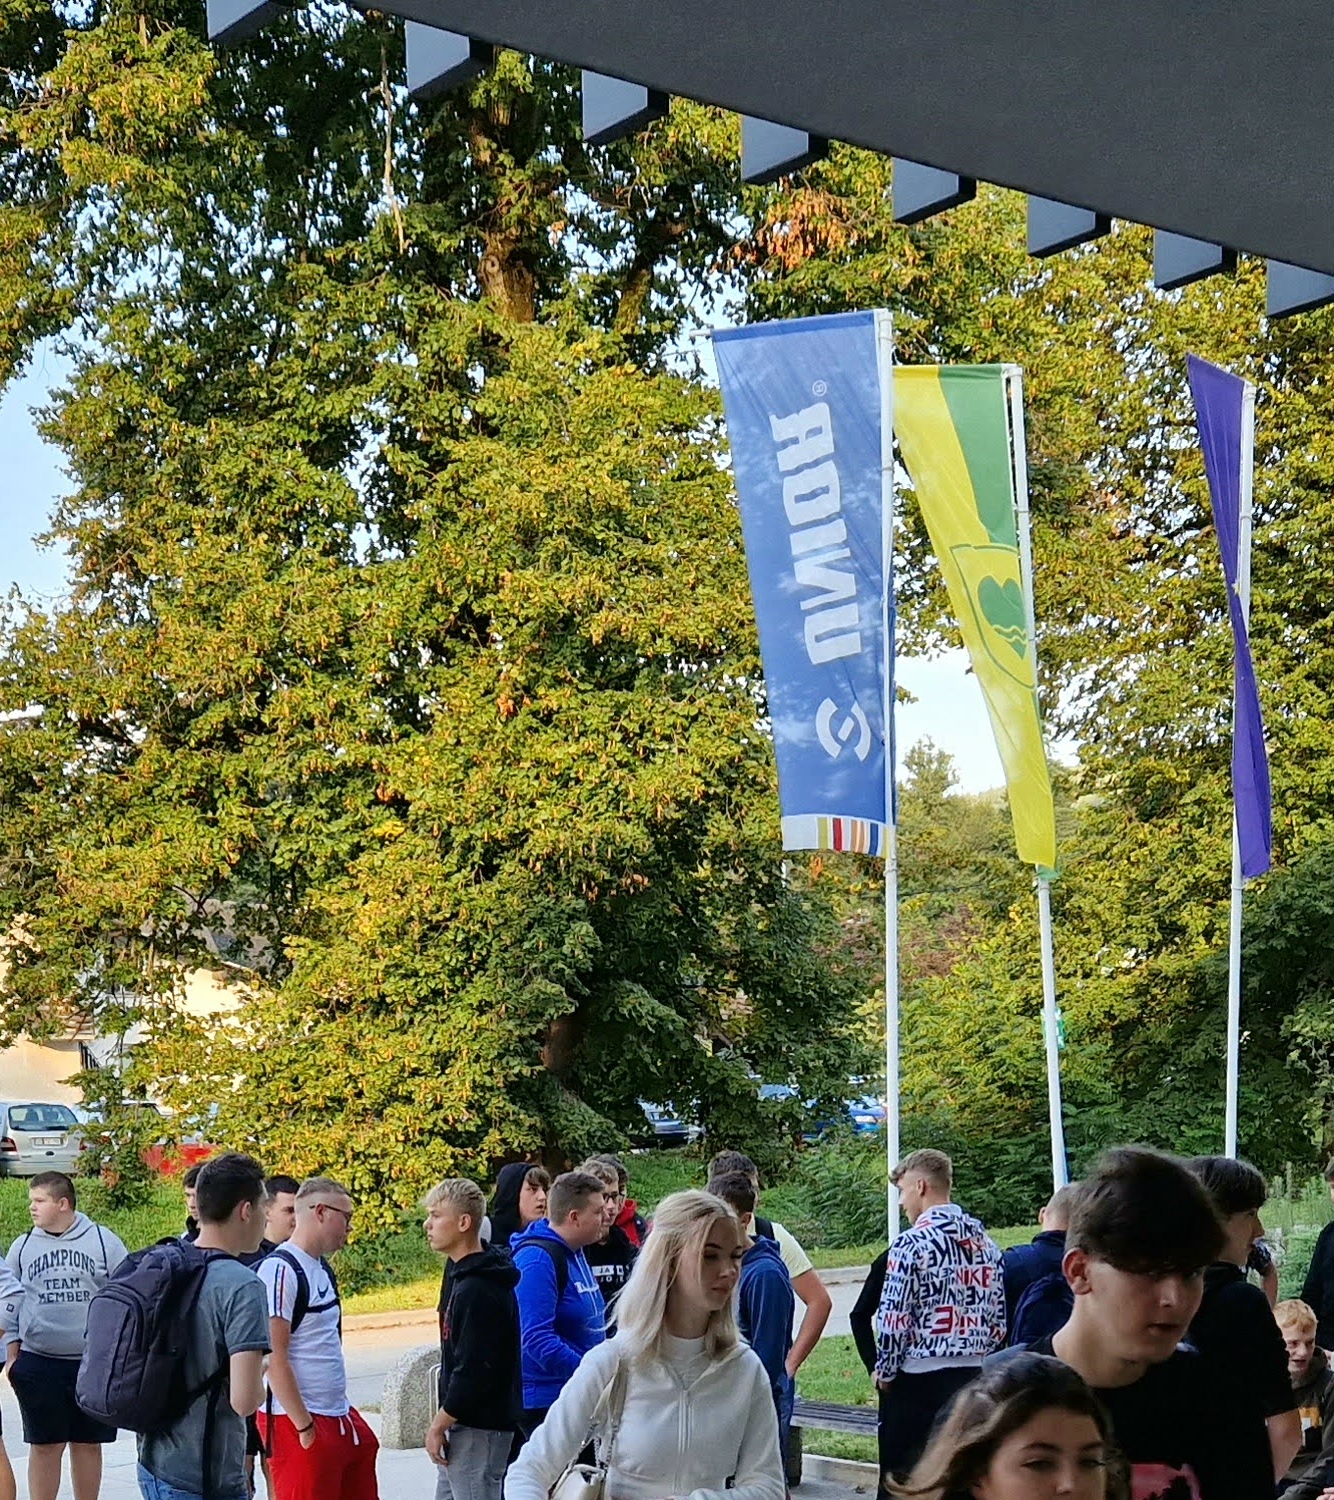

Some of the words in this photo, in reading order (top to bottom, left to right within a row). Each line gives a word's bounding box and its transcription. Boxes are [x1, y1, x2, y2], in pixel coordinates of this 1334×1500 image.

[28, 1249, 96, 1281] CHAMPIONS
[43, 1278, 80, 1290] TEAM
[38, 1290, 91, 1304] MEMBER
